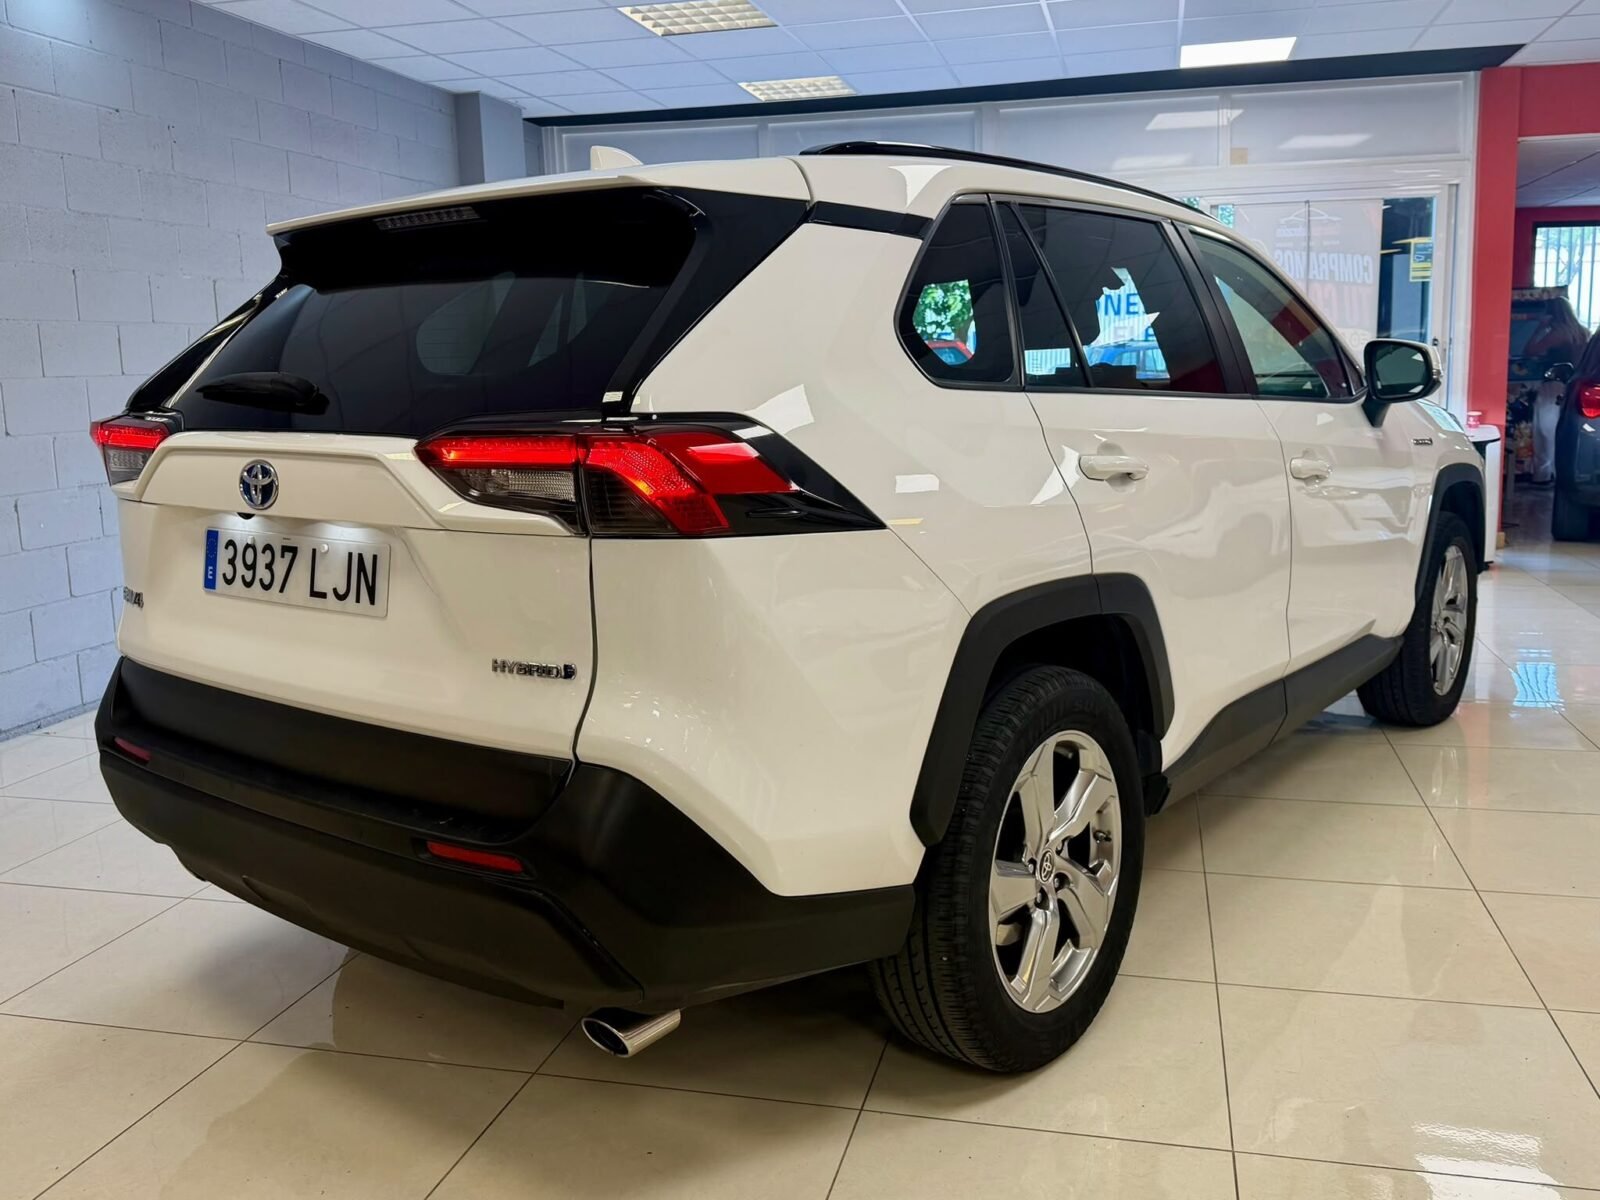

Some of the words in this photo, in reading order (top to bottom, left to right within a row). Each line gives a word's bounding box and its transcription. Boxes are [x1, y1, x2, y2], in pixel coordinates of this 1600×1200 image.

[207, 566, 214, 579] E
[222, 539, 299, 593] 3937
[309, 547, 378, 606] LJN
[491, 658, 562, 679] HYBRID
